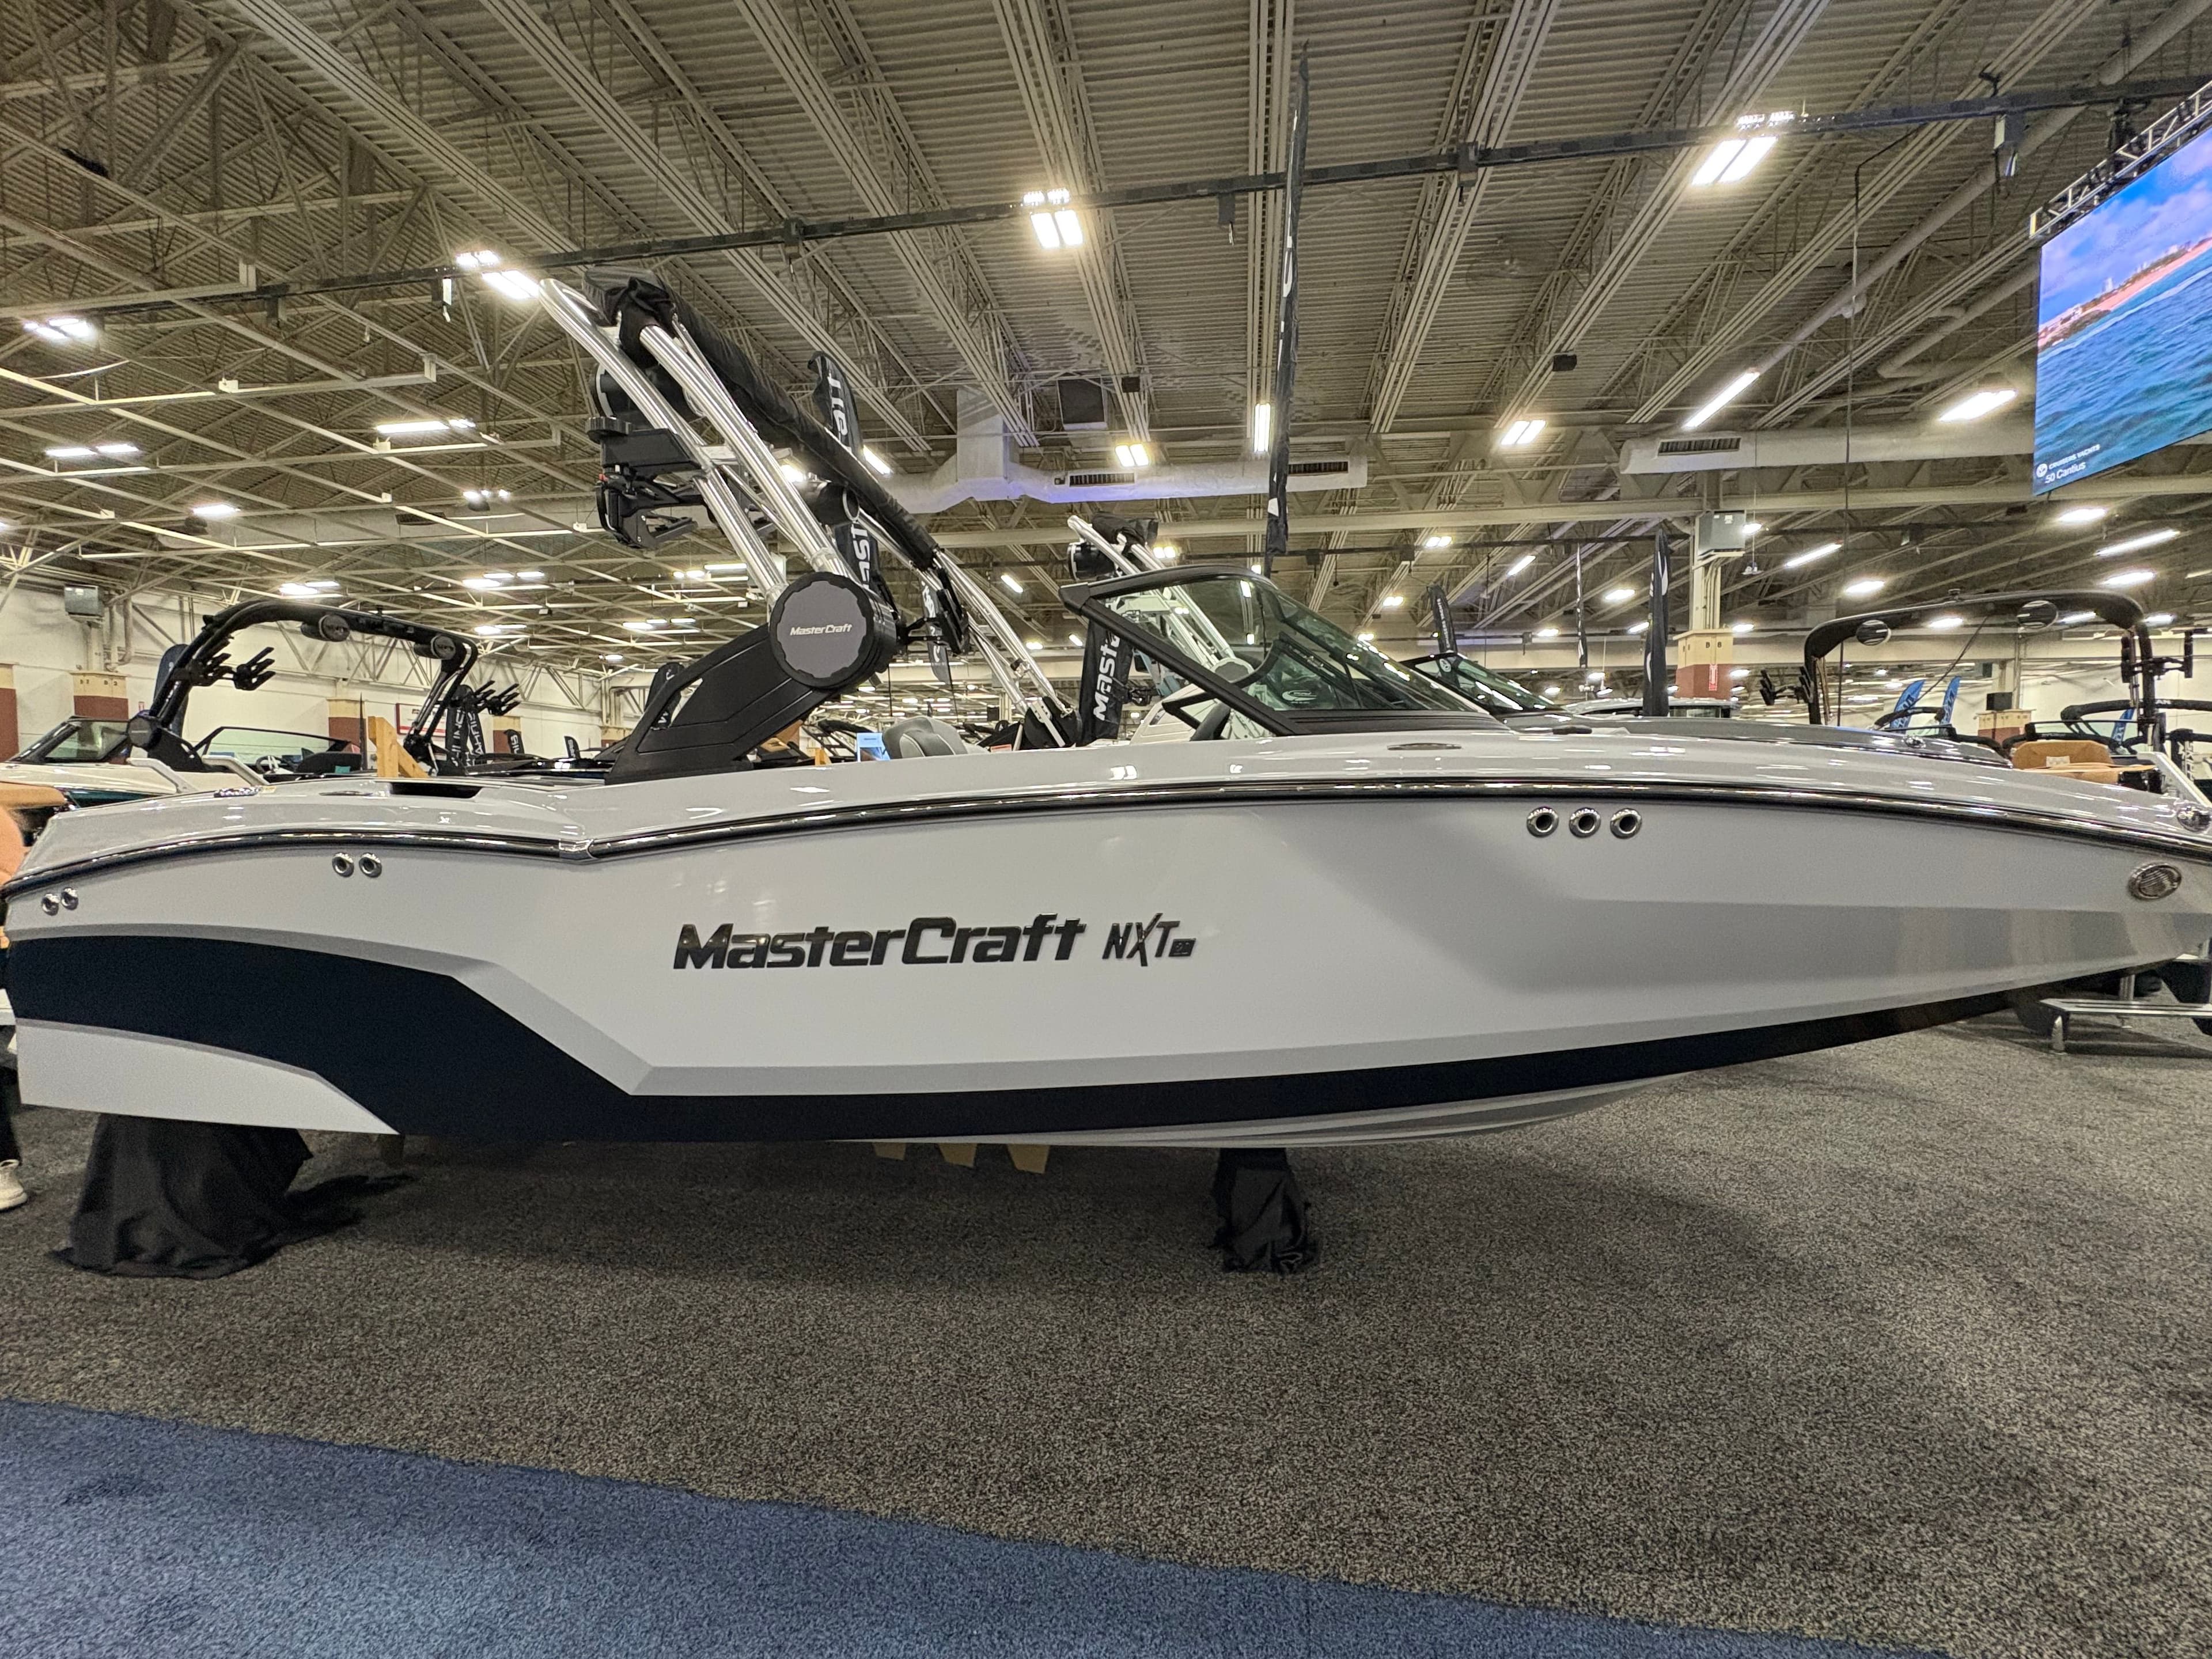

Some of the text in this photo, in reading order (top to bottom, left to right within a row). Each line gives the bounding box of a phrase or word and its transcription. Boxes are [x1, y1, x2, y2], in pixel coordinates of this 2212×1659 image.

[2056, 462, 2086, 479] Cantius
[789, 623, 853, 636] MasterCraft
[673, 912, 1086, 969] MasterCraft
[1102, 912, 1181, 967] NXT
